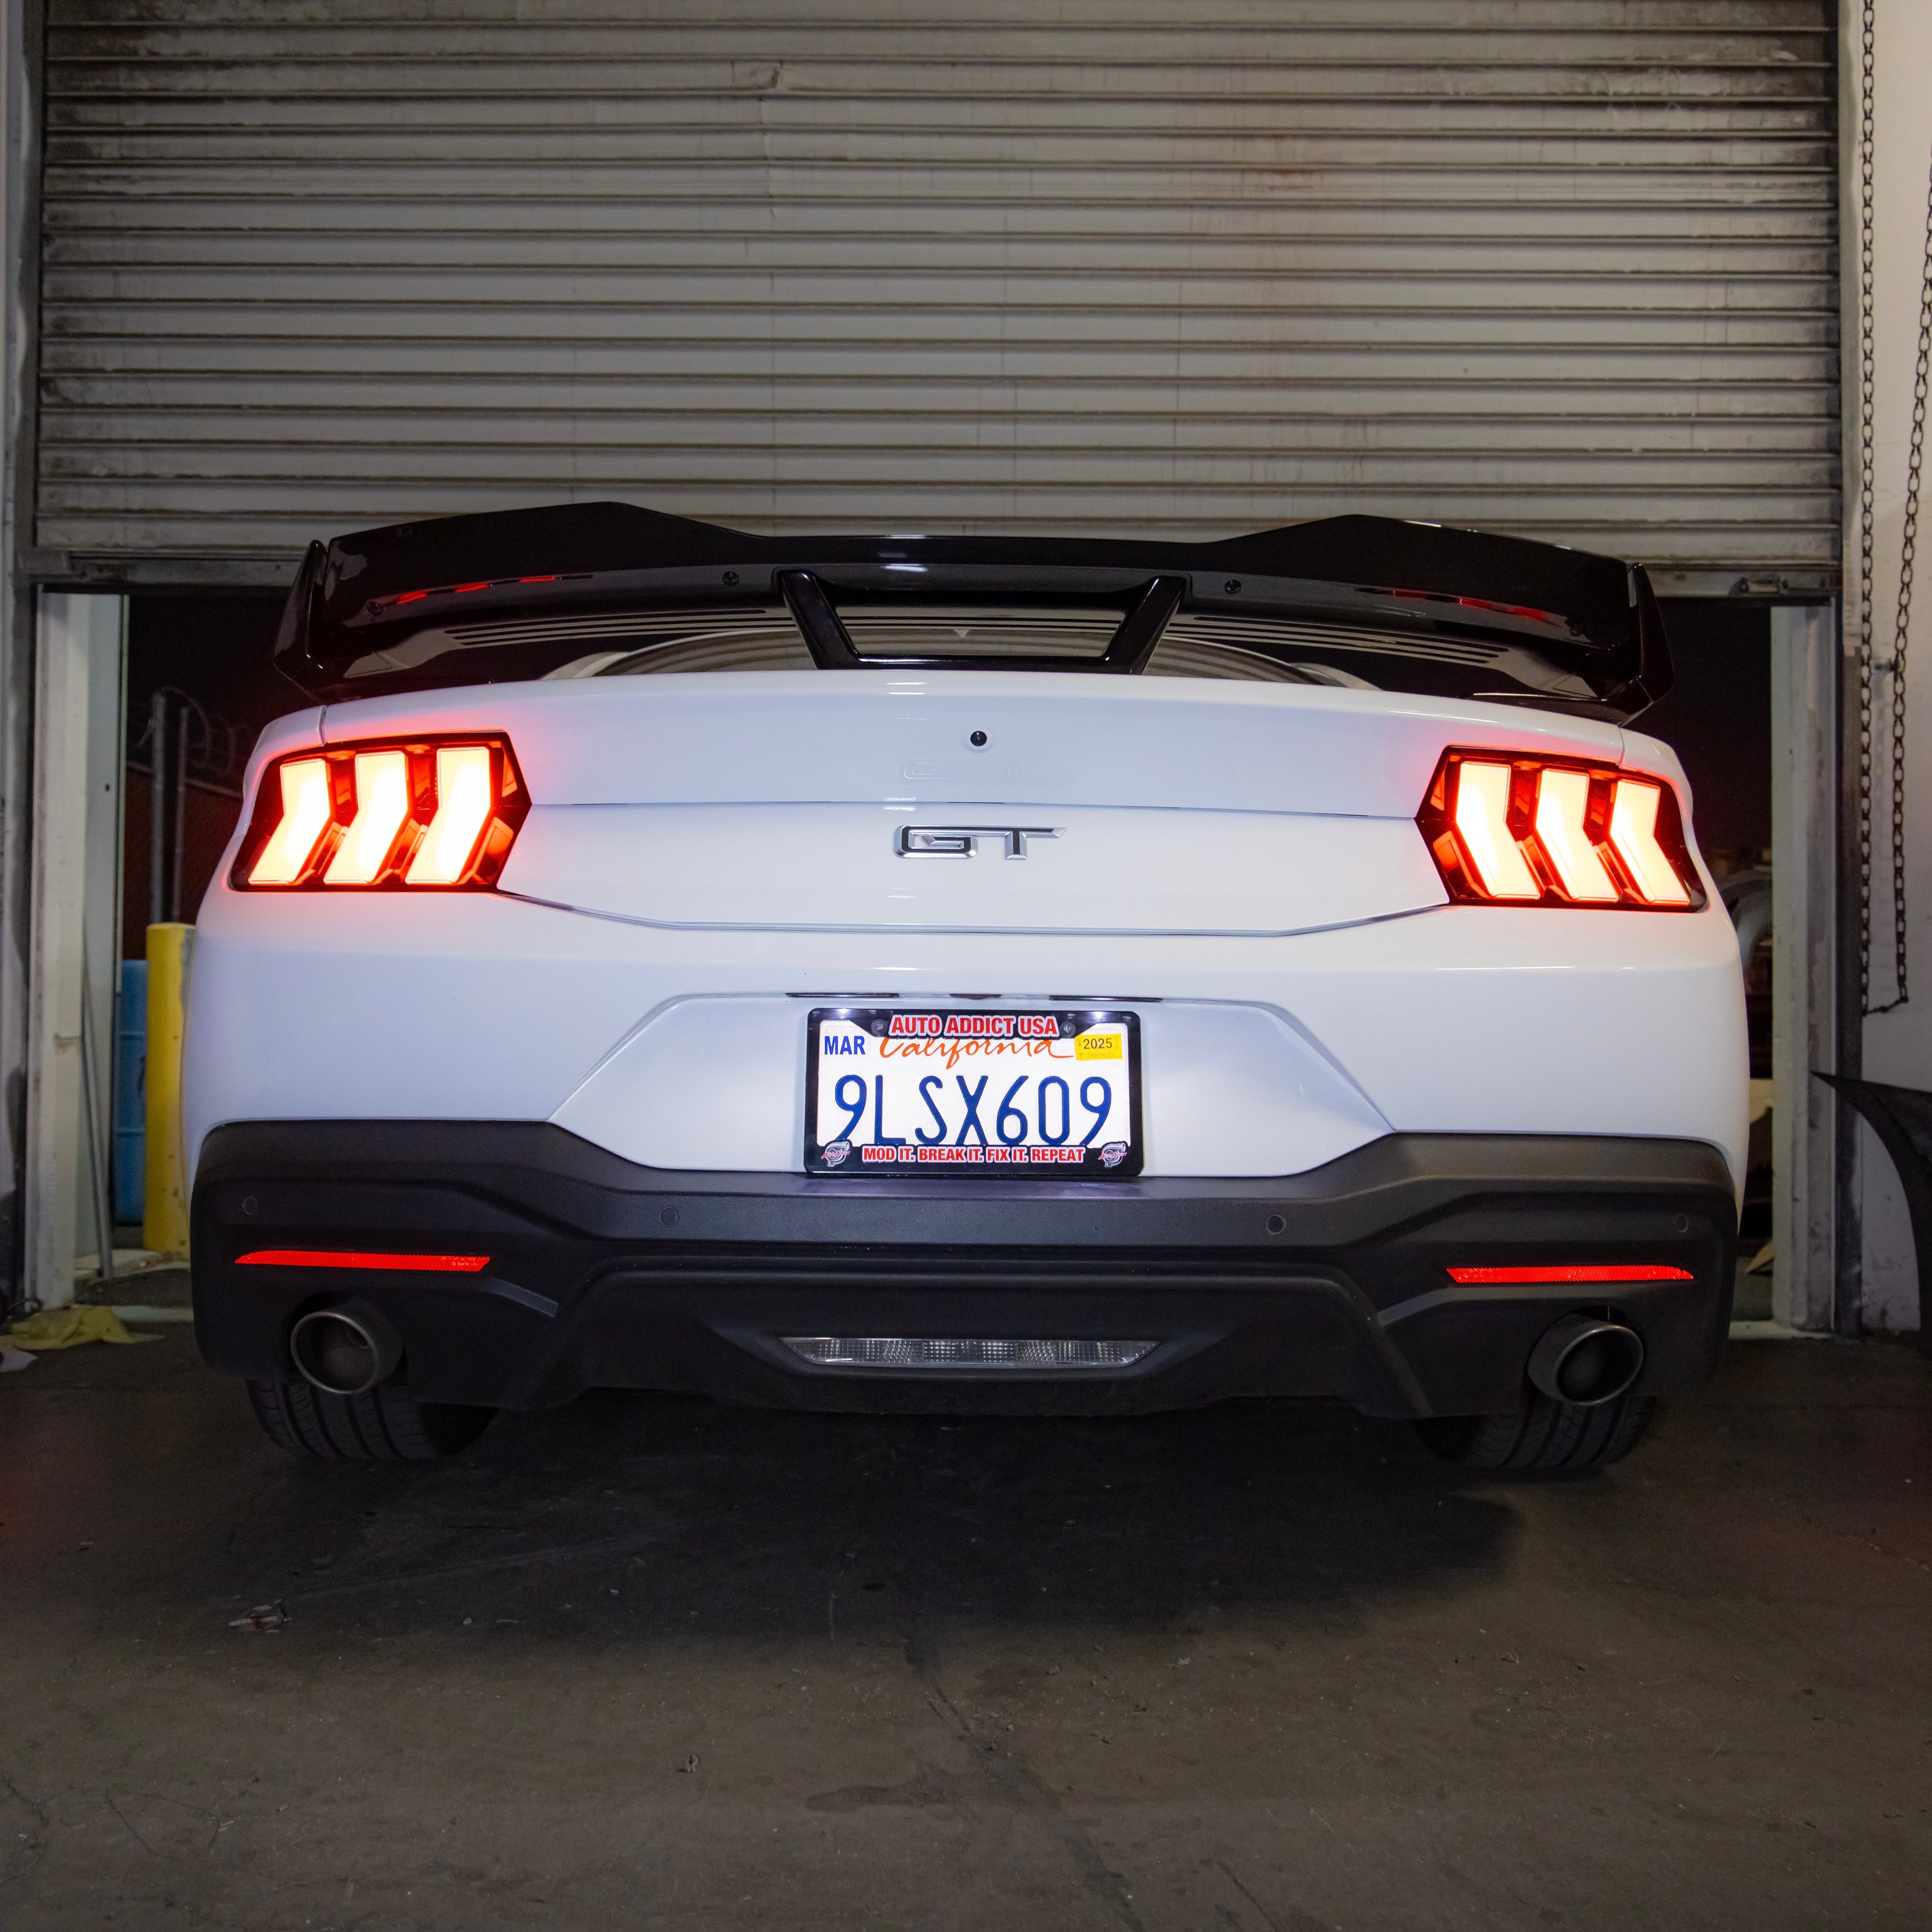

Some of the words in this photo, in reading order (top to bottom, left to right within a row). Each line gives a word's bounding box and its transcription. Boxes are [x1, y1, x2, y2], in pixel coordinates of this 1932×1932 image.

[893, 825, 1067, 860] GT
[891, 1016, 941, 1034] AUTO
[946, 1017, 1014, 1035] ADDICT
[1020, 1018, 1057, 1035] USA
[824, 1036, 866, 1055] MAR
[1083, 1038, 1112, 1049] 2025
[834, 1074, 1111, 1146] 9LSX609
[863, 1148, 896, 1160] MOD
[899, 1148, 914, 1160] IT.
[919, 1148, 965, 1161] BREAK
[968, 1148, 982, 1161] IT.
[987, 1148, 1009, 1161] FIX
[1013, 1148, 1027, 1161] IT.
[1032, 1148, 1084, 1161] REPEAT
